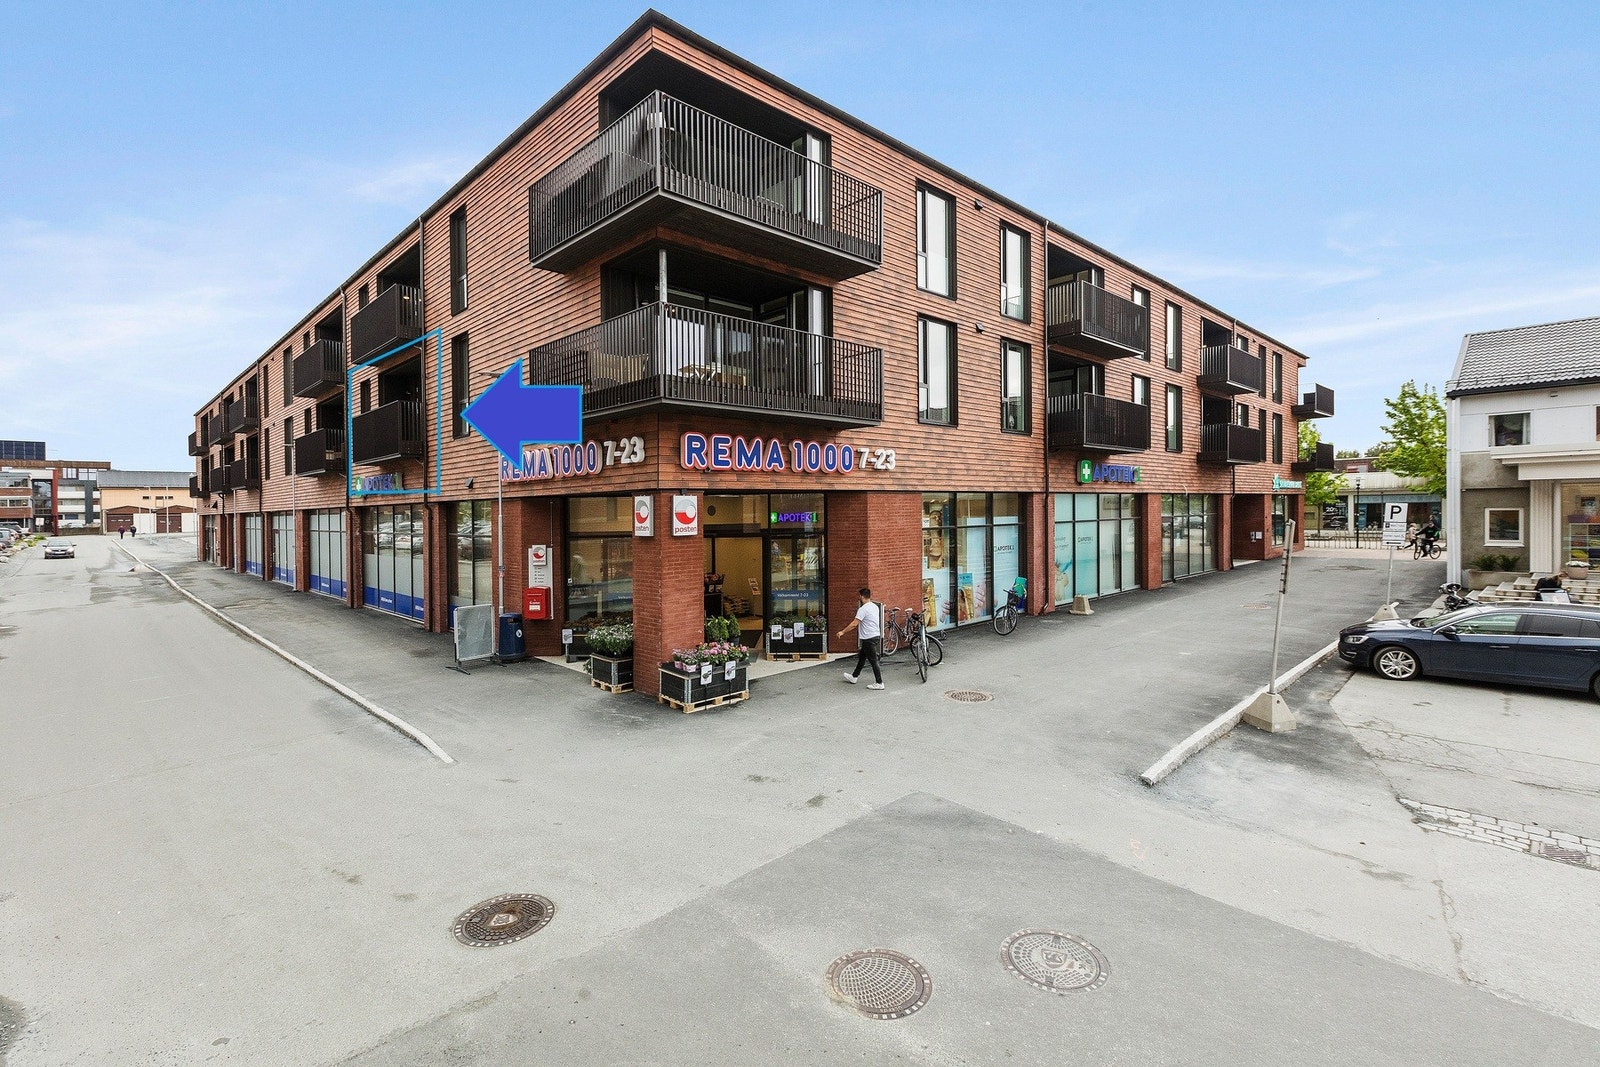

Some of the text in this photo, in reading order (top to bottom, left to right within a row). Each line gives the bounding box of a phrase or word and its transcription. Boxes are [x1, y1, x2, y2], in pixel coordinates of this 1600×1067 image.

[551, 441, 602, 479] 1000
[604, 436, 646, 466] 7-23
[680, 432, 896, 475] REMA 1000 7-23
[1092, 463, 1136, 483] APOTEK
[778, 512, 812, 523] APOTEK
[1390, 505, 1402, 520] P
